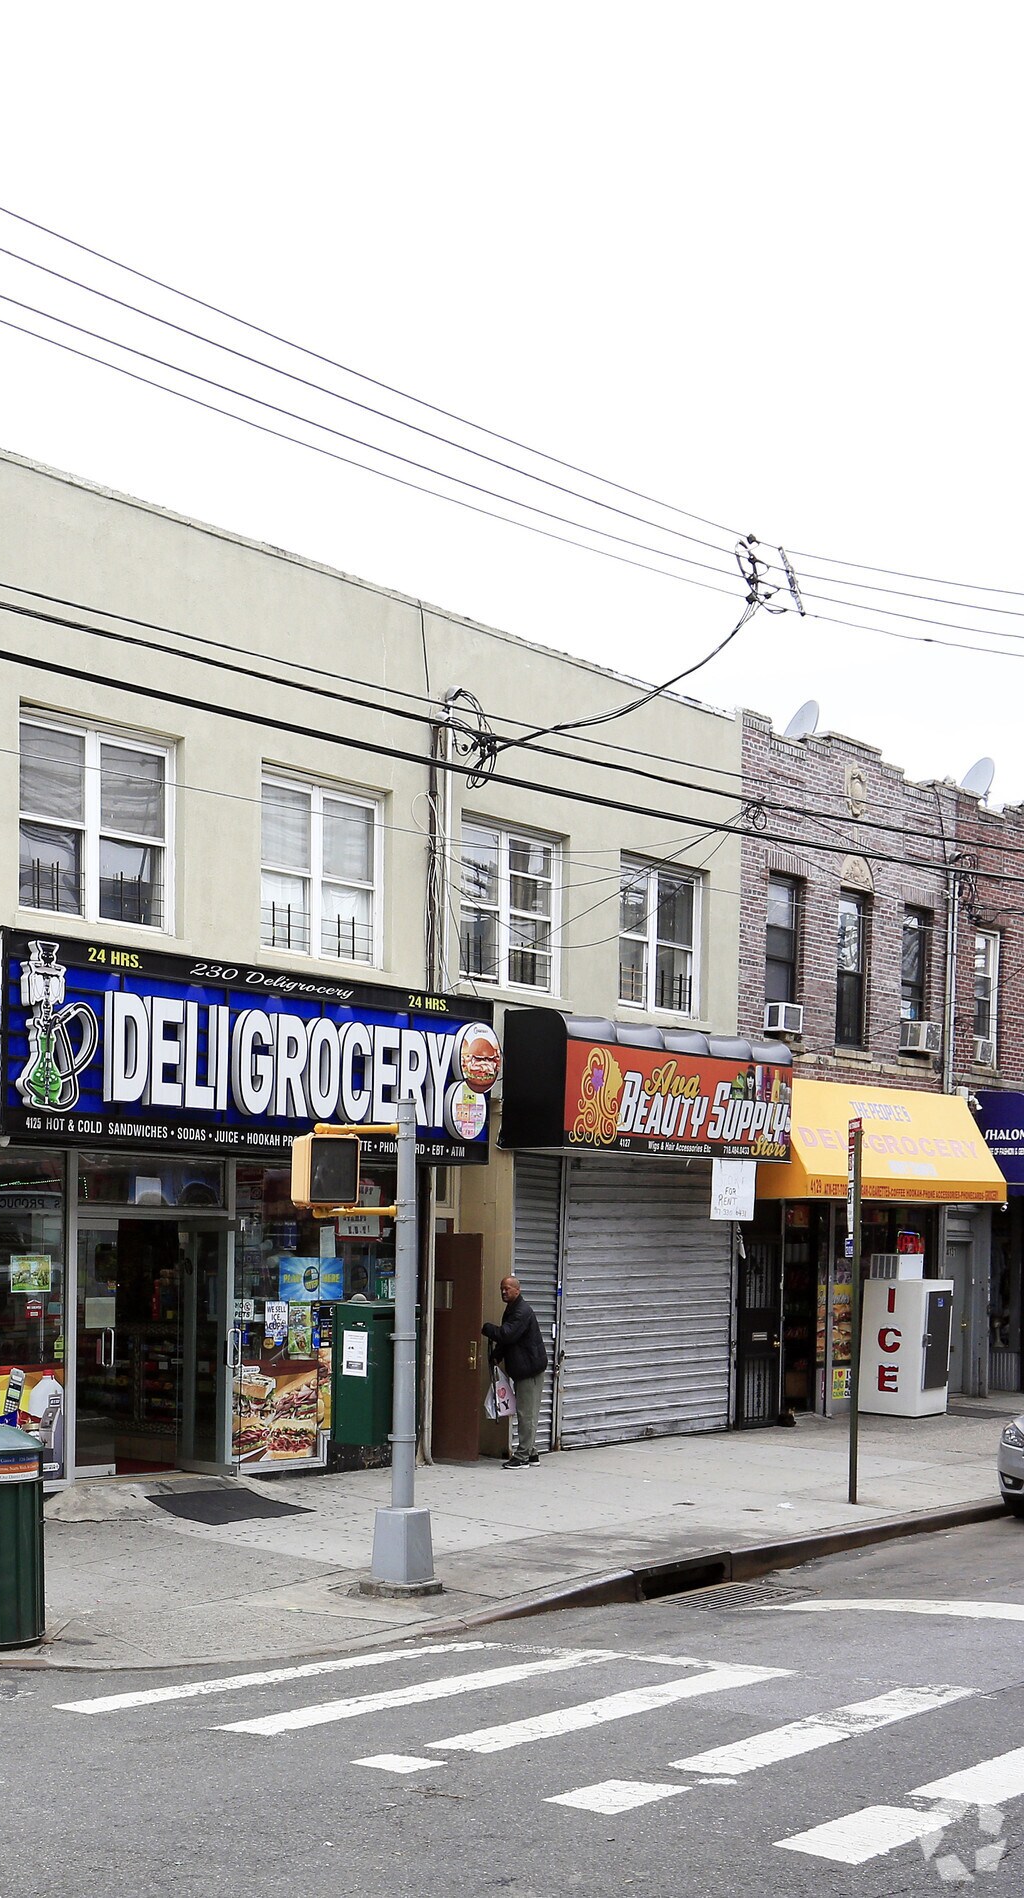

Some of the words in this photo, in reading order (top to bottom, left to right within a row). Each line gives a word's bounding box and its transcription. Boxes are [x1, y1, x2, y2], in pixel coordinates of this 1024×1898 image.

[88, 947, 106, 963] 24
[111, 951, 143, 969] HRS.
[190, 963, 238, 981] 230
[245, 969, 354, 1000] Deligrocery
[408, 995, 422, 1009] 24
[425, 998, 449, 1012] HRS.
[644, 1060, 700, 1099] Ava
[617, 1070, 709, 1138] BEAUTY
[707, 1081, 789, 1142] SUPPLY
[849, 1101, 870, 1119] THE
[26, 1116, 42, 1129] 4125
[46, 1117, 65, 1131] HOT
[68, 1119, 74, 1132] &
[78, 1120, 102, 1134] COLD
[108, 1122, 168, 1138] SANDWICHES
[177, 1127, 206, 1141] SODAS
[214, 1130, 239, 1144] JUICE
[247, 1132, 280, 1146] HOOKAH
[379, 1141, 398, 1153] PHON
[432, 1144, 444, 1156] EBT
[450, 1146, 465, 1157] ATM
[619, 1138, 631, 1148] 4127
[648, 1140, 660, 1152] Wigs
[665, 1142, 675, 1151] Hair
[675, 1143, 703, 1153] Accessories
[751, 1134, 787, 1158] Store
[797, 1126, 849, 1150] DEL
[868, 1134, 979, 1159] GROCERY
[718, 1194, 737, 1207] RENT
[725, 1186, 737, 1196] FOR
[267, 1305, 275, 1313] WE
[878, 1286, 902, 1393] ICE
